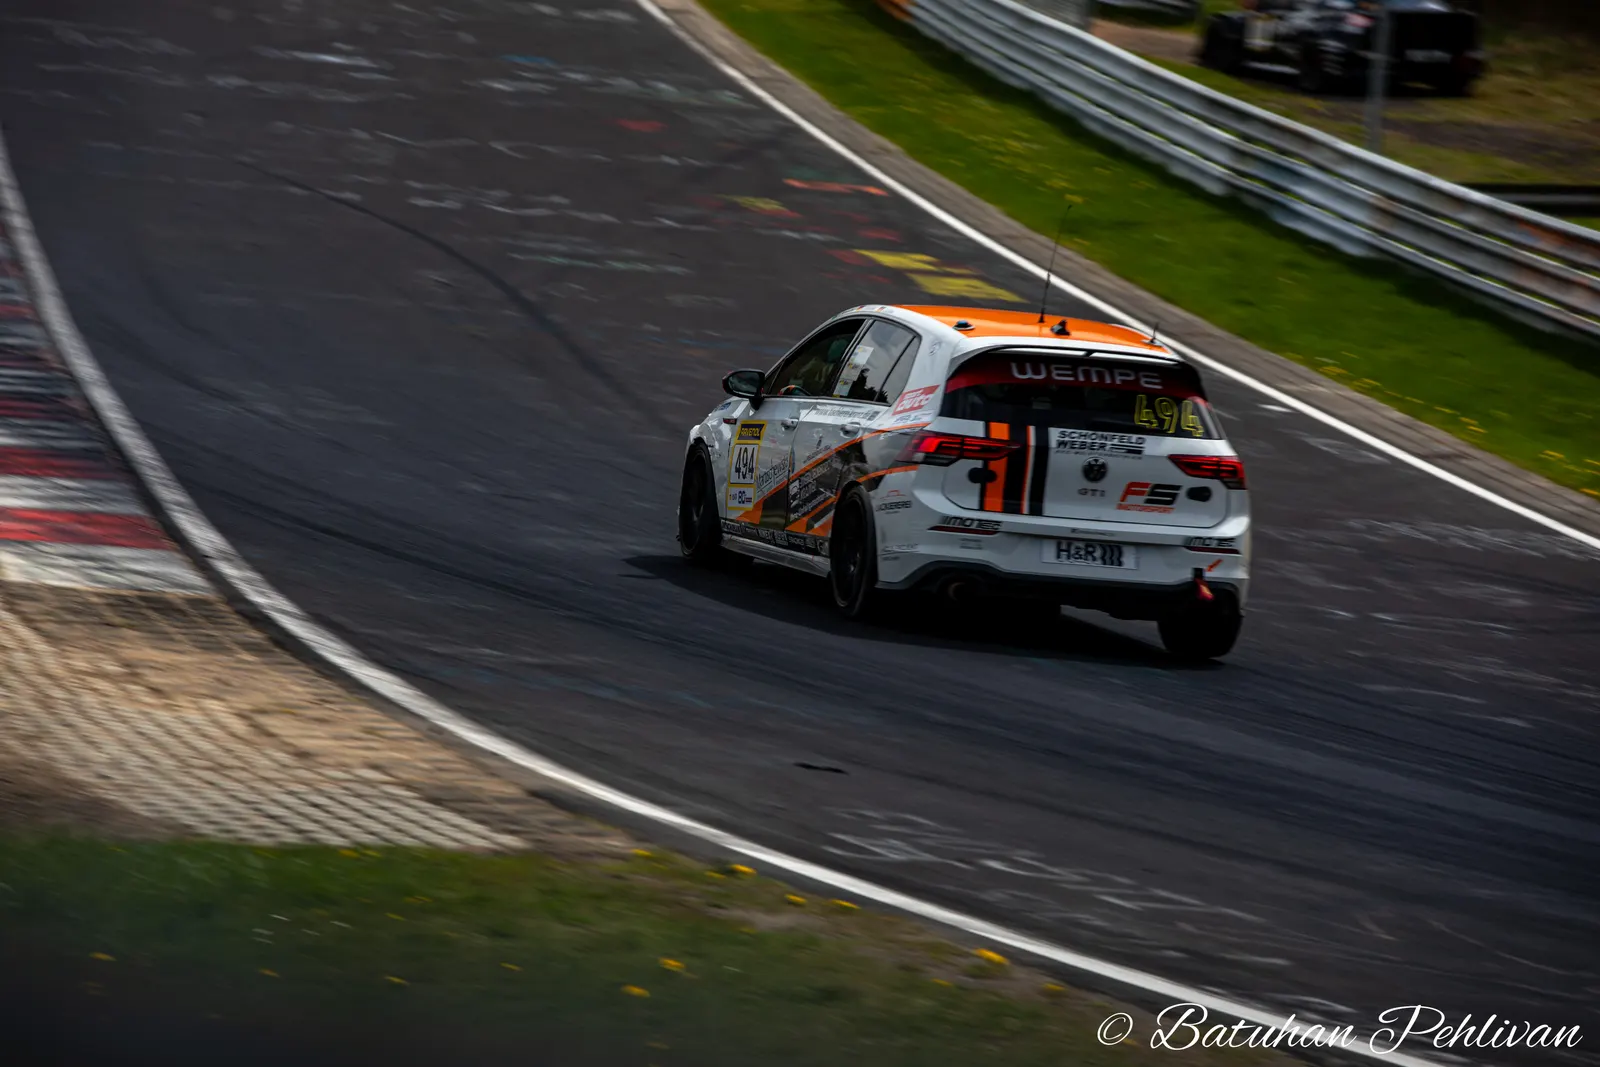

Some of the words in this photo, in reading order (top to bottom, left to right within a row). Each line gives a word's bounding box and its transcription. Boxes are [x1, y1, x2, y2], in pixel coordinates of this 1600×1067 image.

[1010, 362, 1164, 389] WEMPE
[898, 394, 931, 413] auto
[1134, 394, 1204, 438] 494
[1055, 439, 1109, 452] WEBER
[734, 446, 755, 480] 494
[1077, 487, 1106, 498] GTI
[1119, 481, 1183, 506] FS
[1056, 540, 1098, 562] H&R
